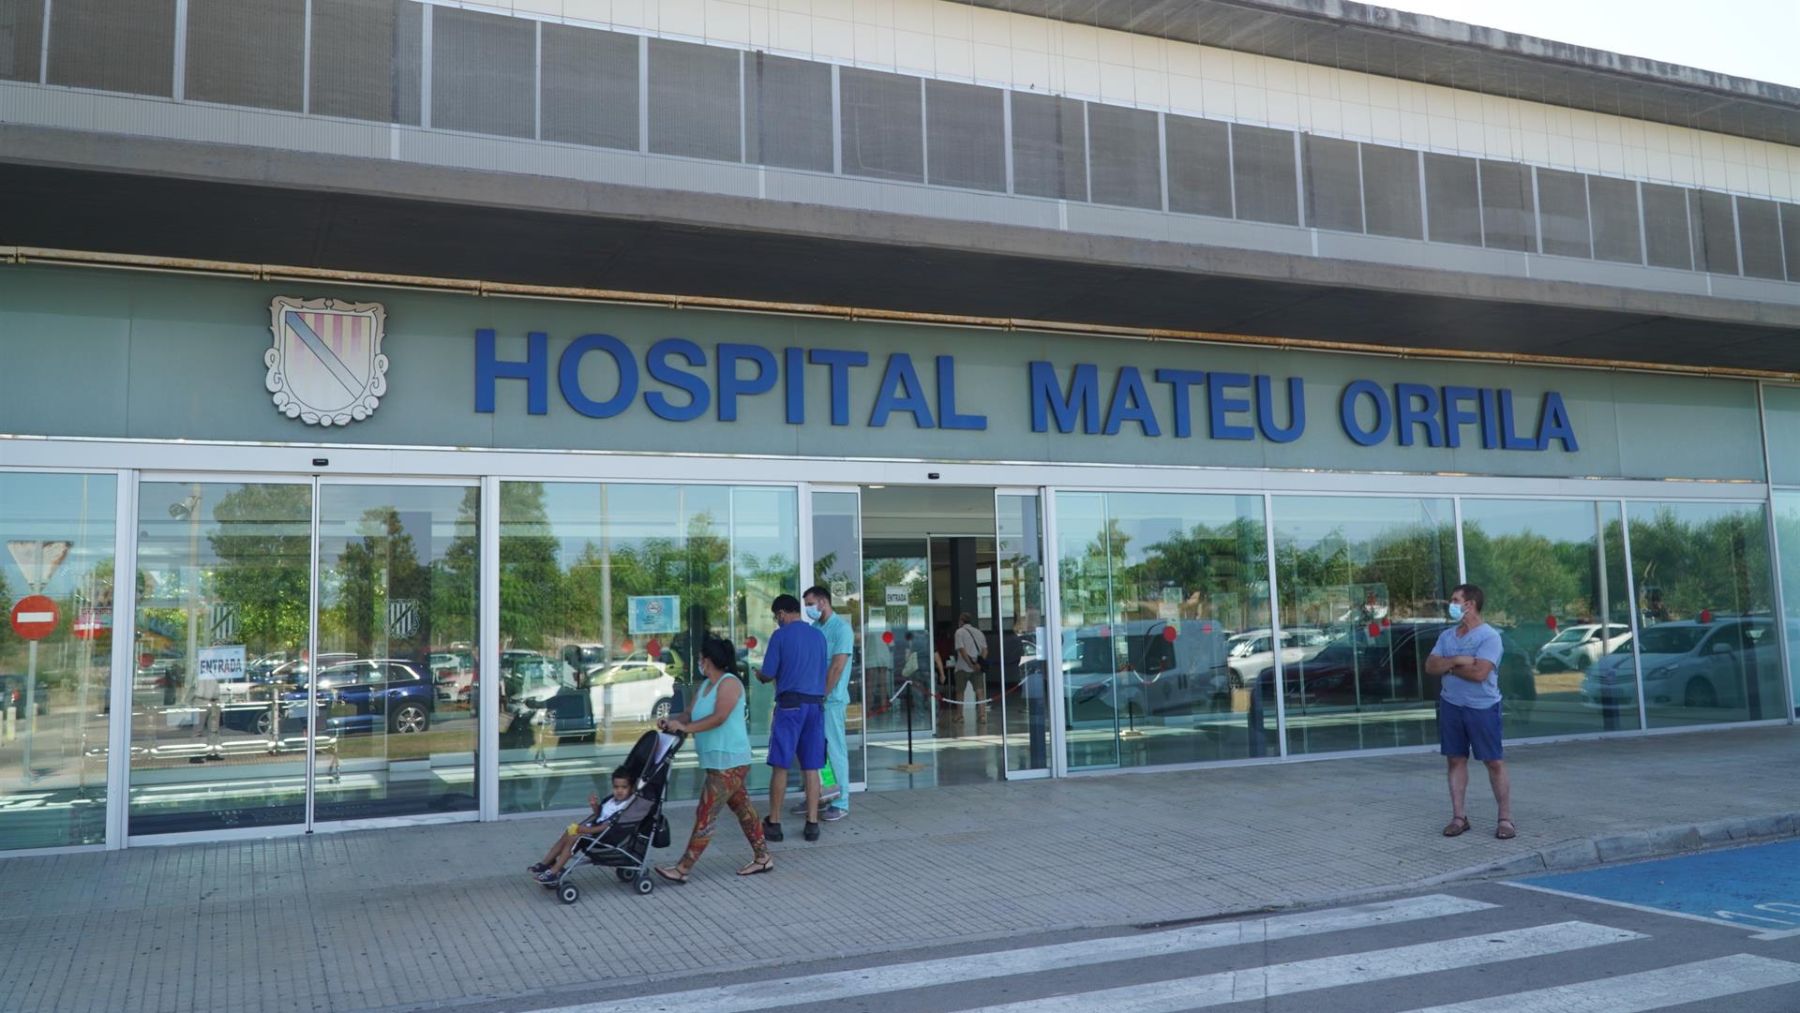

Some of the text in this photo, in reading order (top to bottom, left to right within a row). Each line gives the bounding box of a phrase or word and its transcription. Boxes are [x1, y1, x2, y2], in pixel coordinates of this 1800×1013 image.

[475, 330, 1579, 452] HOSPITAL MATEU ORFILA
[886, 593, 907, 603] ENTRADA
[200, 658, 243, 675] ENTRADA
